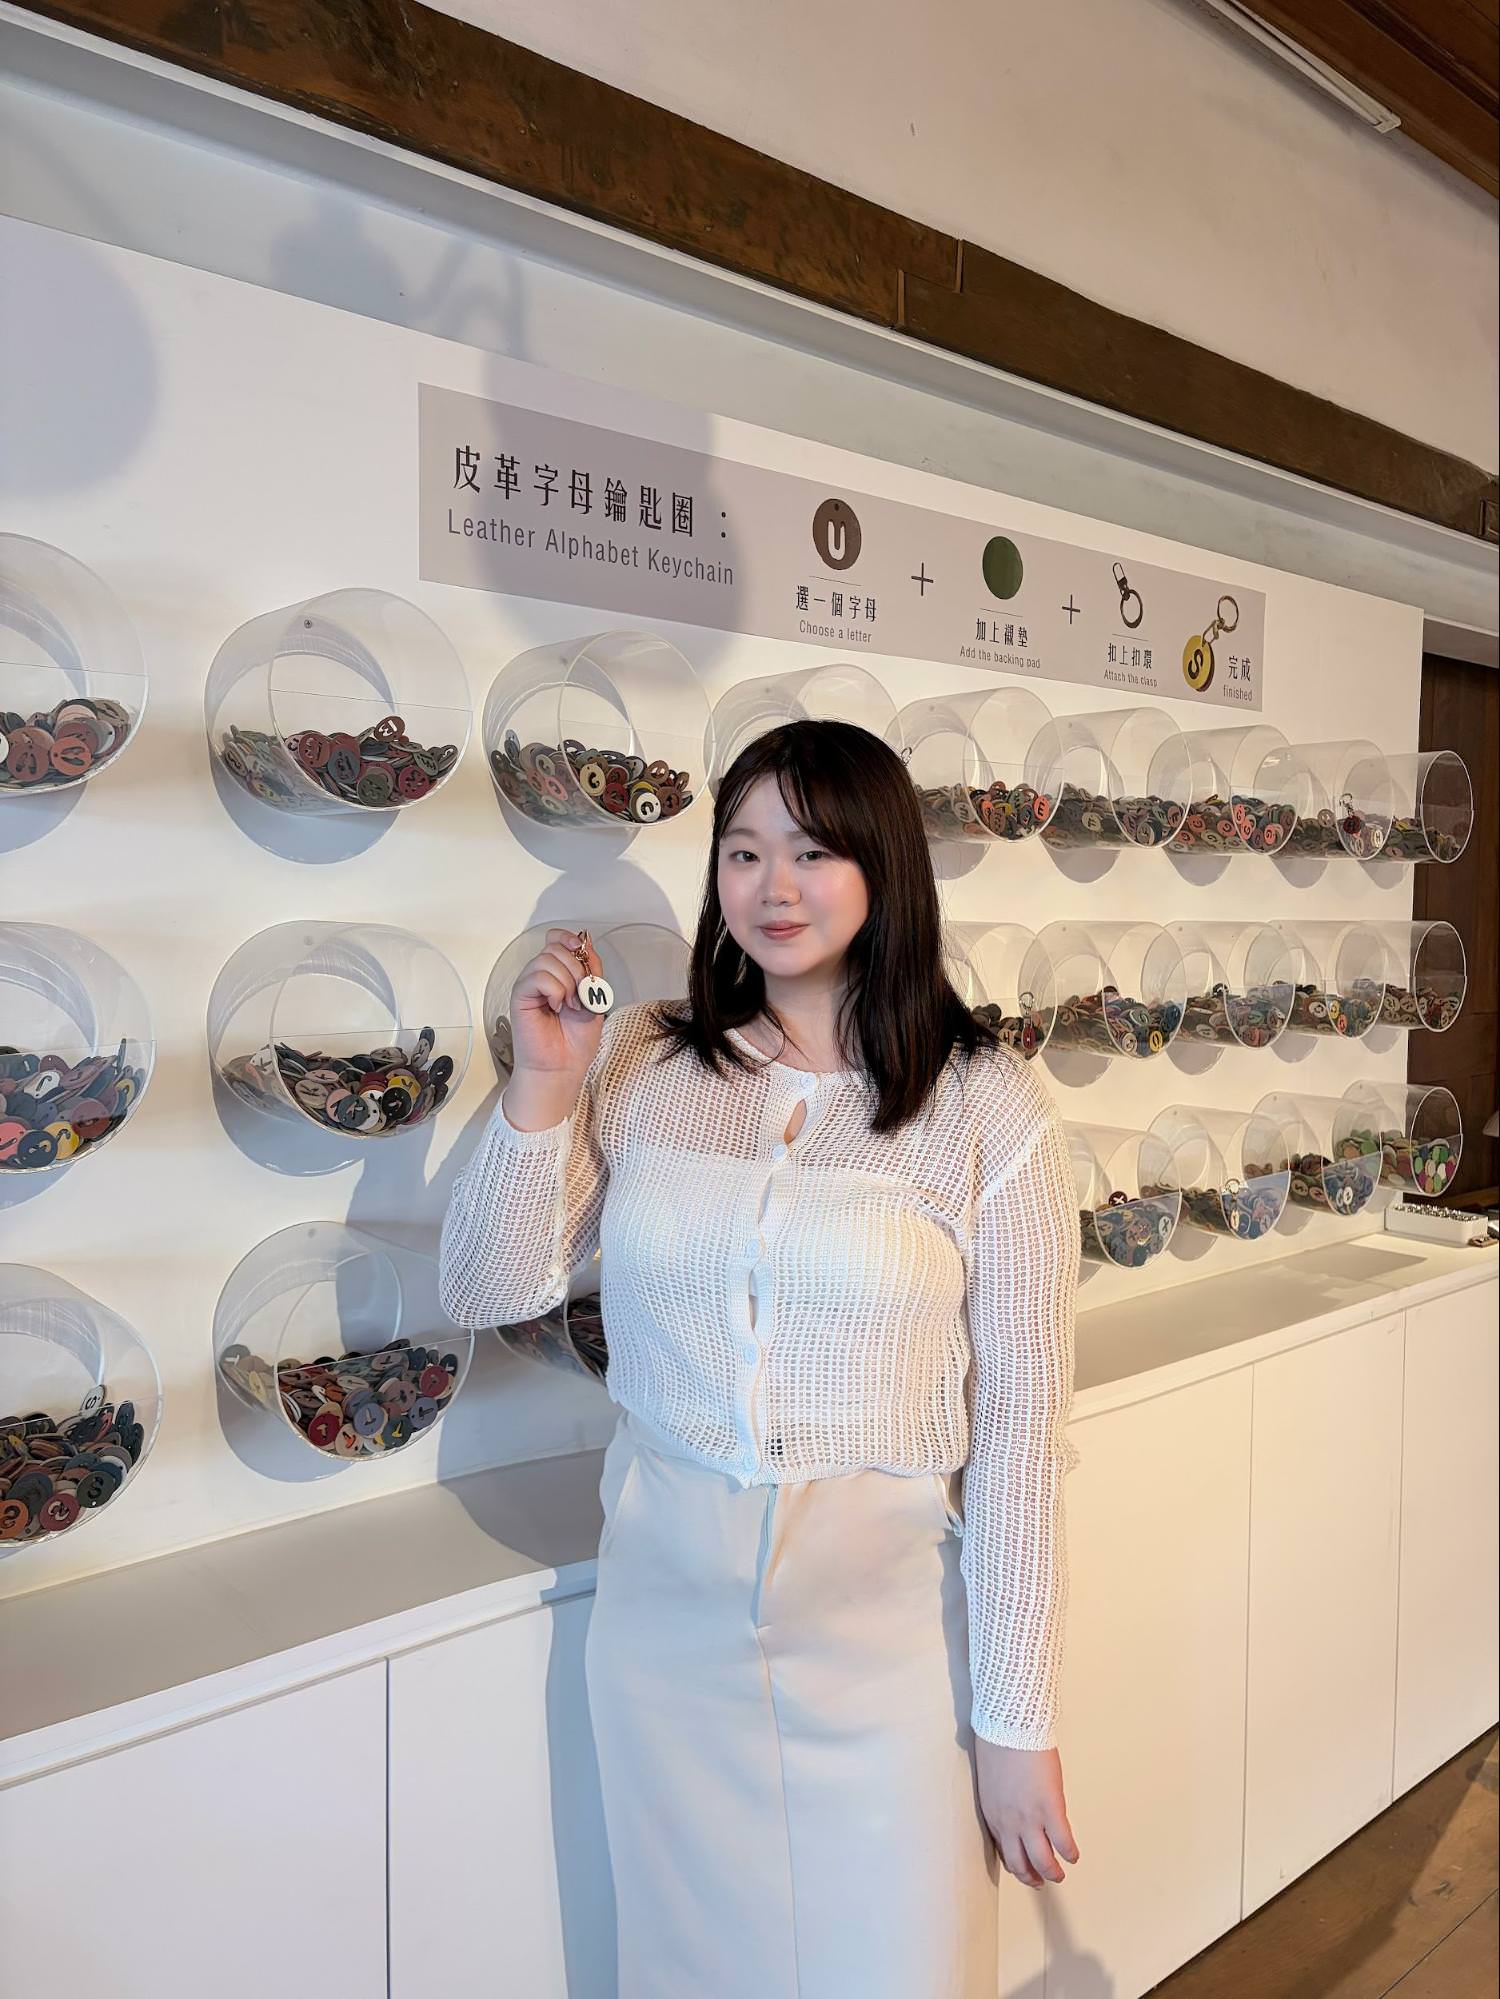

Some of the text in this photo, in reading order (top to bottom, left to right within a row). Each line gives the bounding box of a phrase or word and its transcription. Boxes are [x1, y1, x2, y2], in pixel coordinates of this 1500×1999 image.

[448, 508, 734, 586] Leather Alphabet Keychain
[827, 520, 847, 561] U
[796, 585, 877, 622] 選一個字母
[799, 619, 873, 643] Choose a letter
[975, 617, 1029, 648] 加上襯墊
[960, 645, 1041, 669] Add the backing pad
[1187, 648, 1204, 680] S
[1228, 655, 1251, 682] 完成
[1103, 669, 1158, 688] Attach the clasp
[1223, 684, 1253, 702] finished
[588, 986, 607, 1006] M
